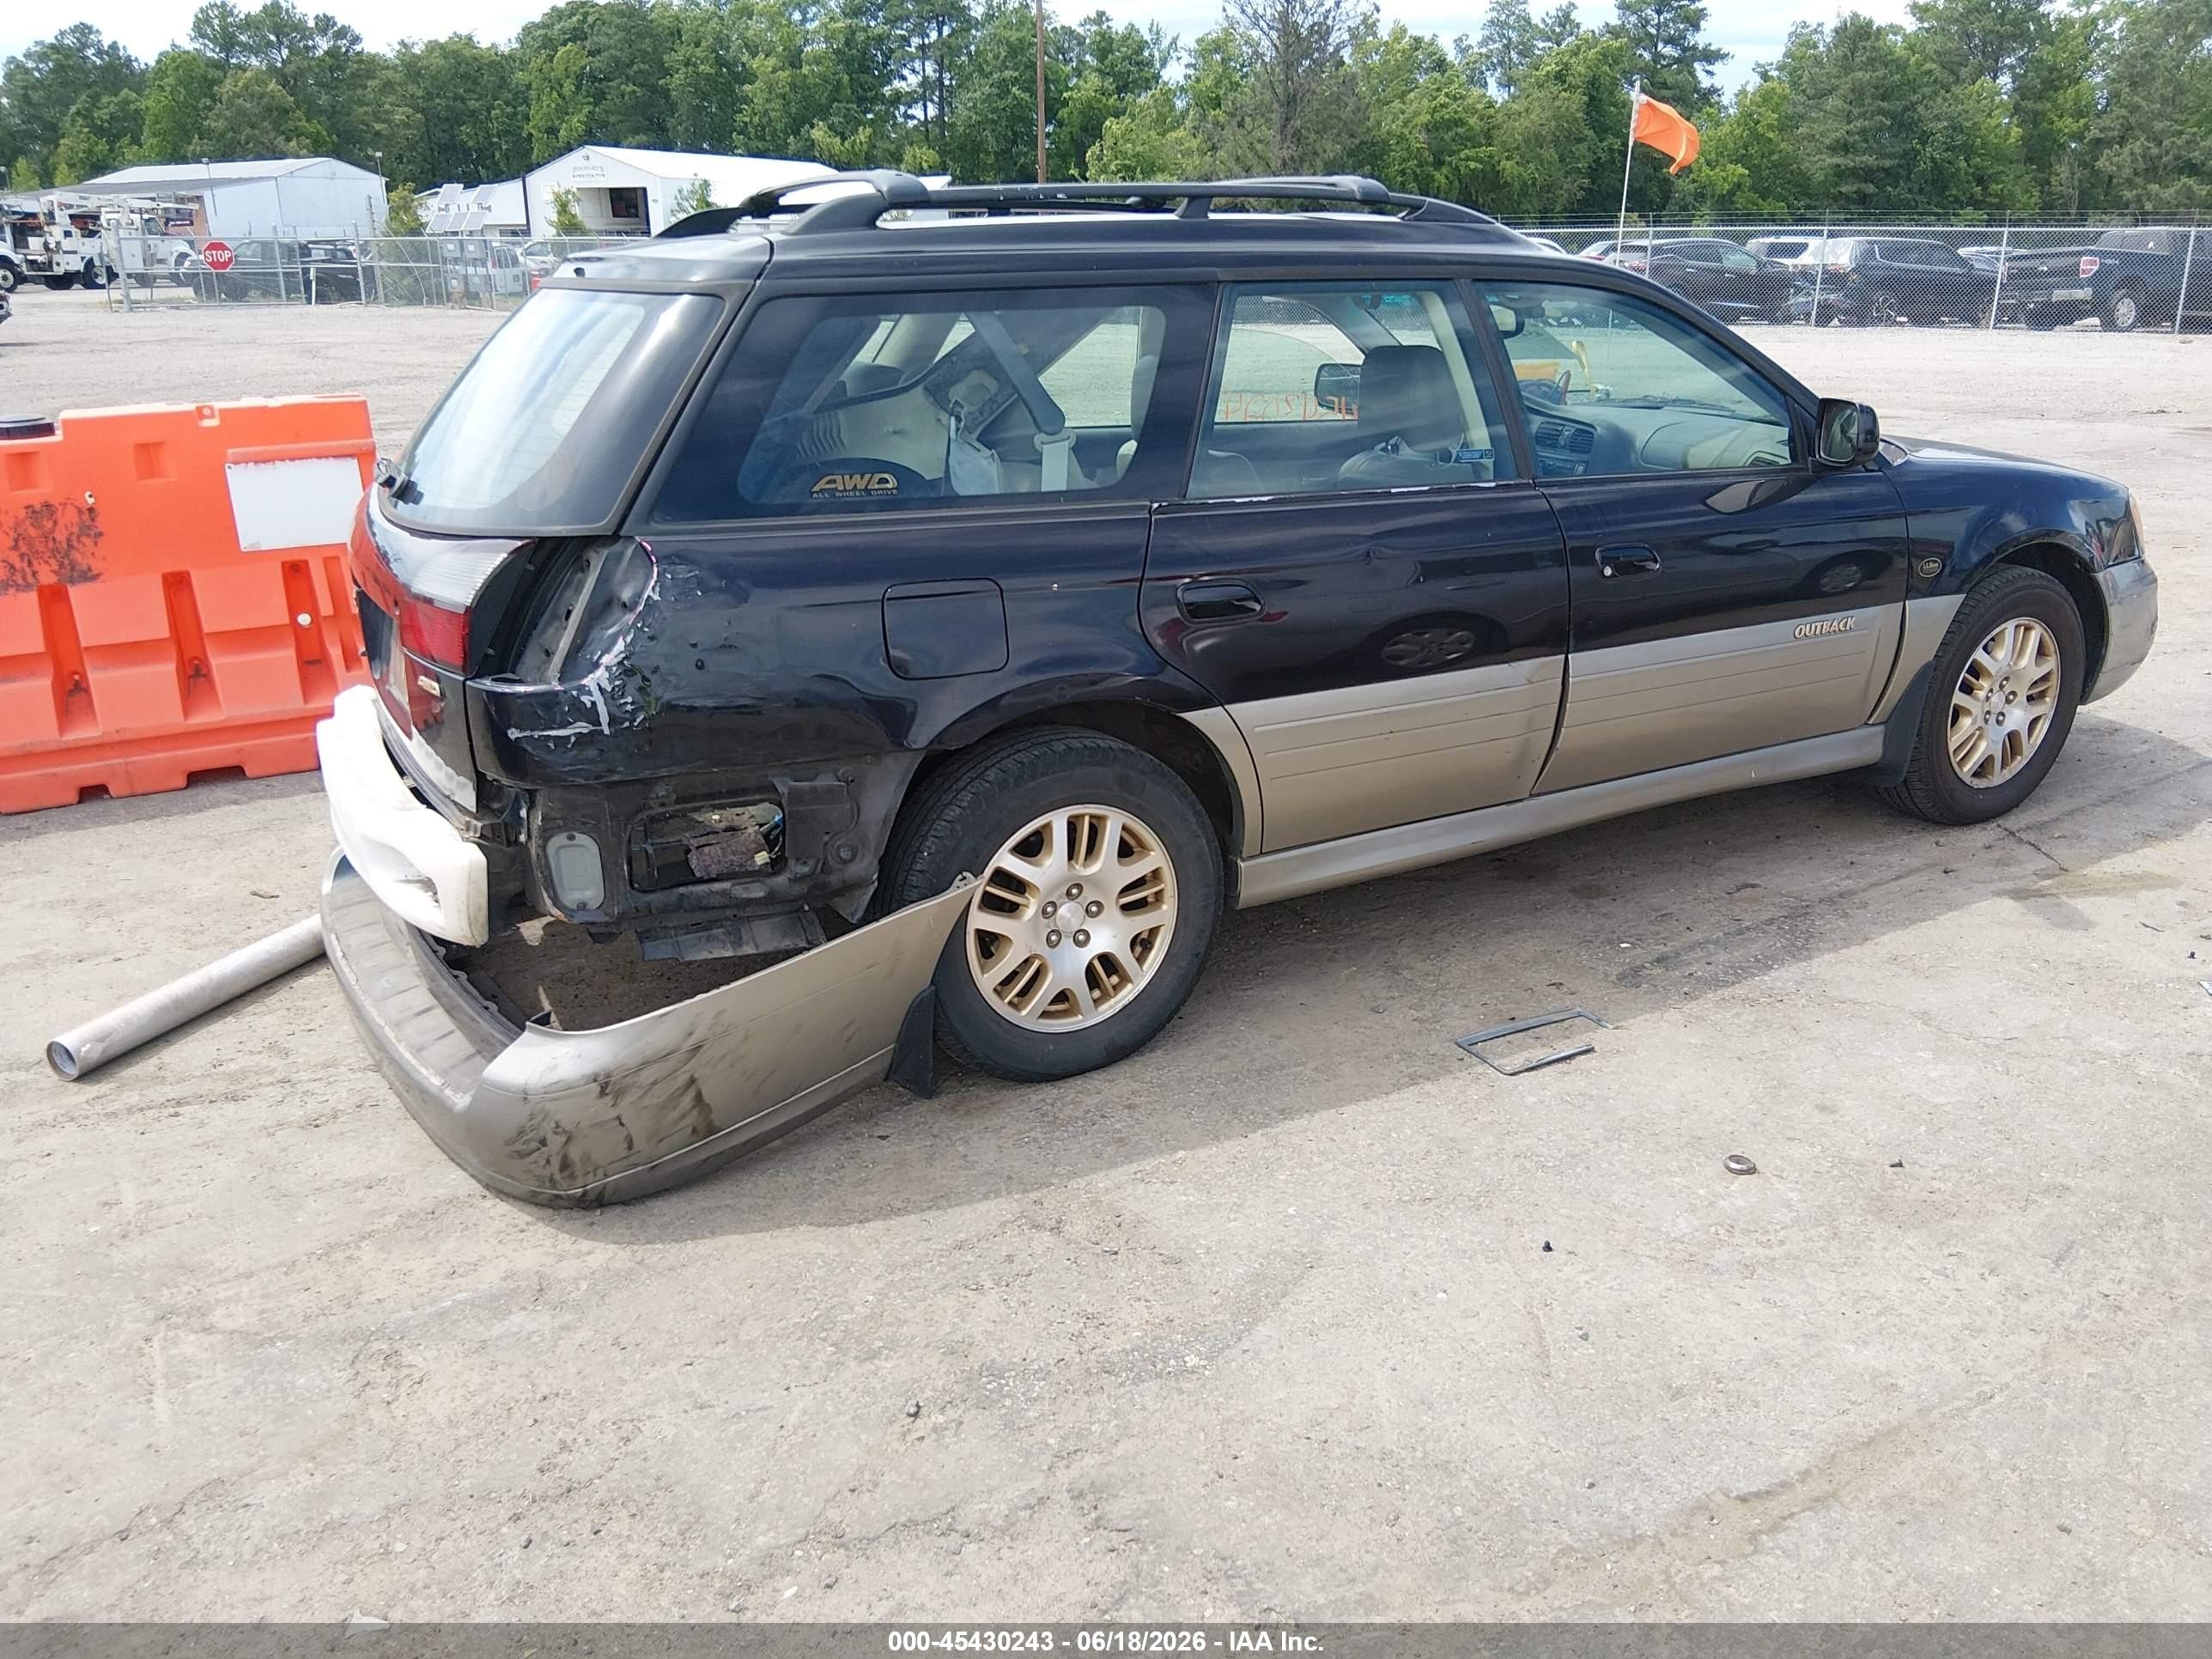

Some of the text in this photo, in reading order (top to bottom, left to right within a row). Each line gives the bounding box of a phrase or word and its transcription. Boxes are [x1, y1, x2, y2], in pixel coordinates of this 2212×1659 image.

[205, 250, 232, 262] STOP
[811, 473, 897, 492] AWD
[835, 489, 866, 498] WHEEL
[1794, 617, 1855, 639] OUTBACK
